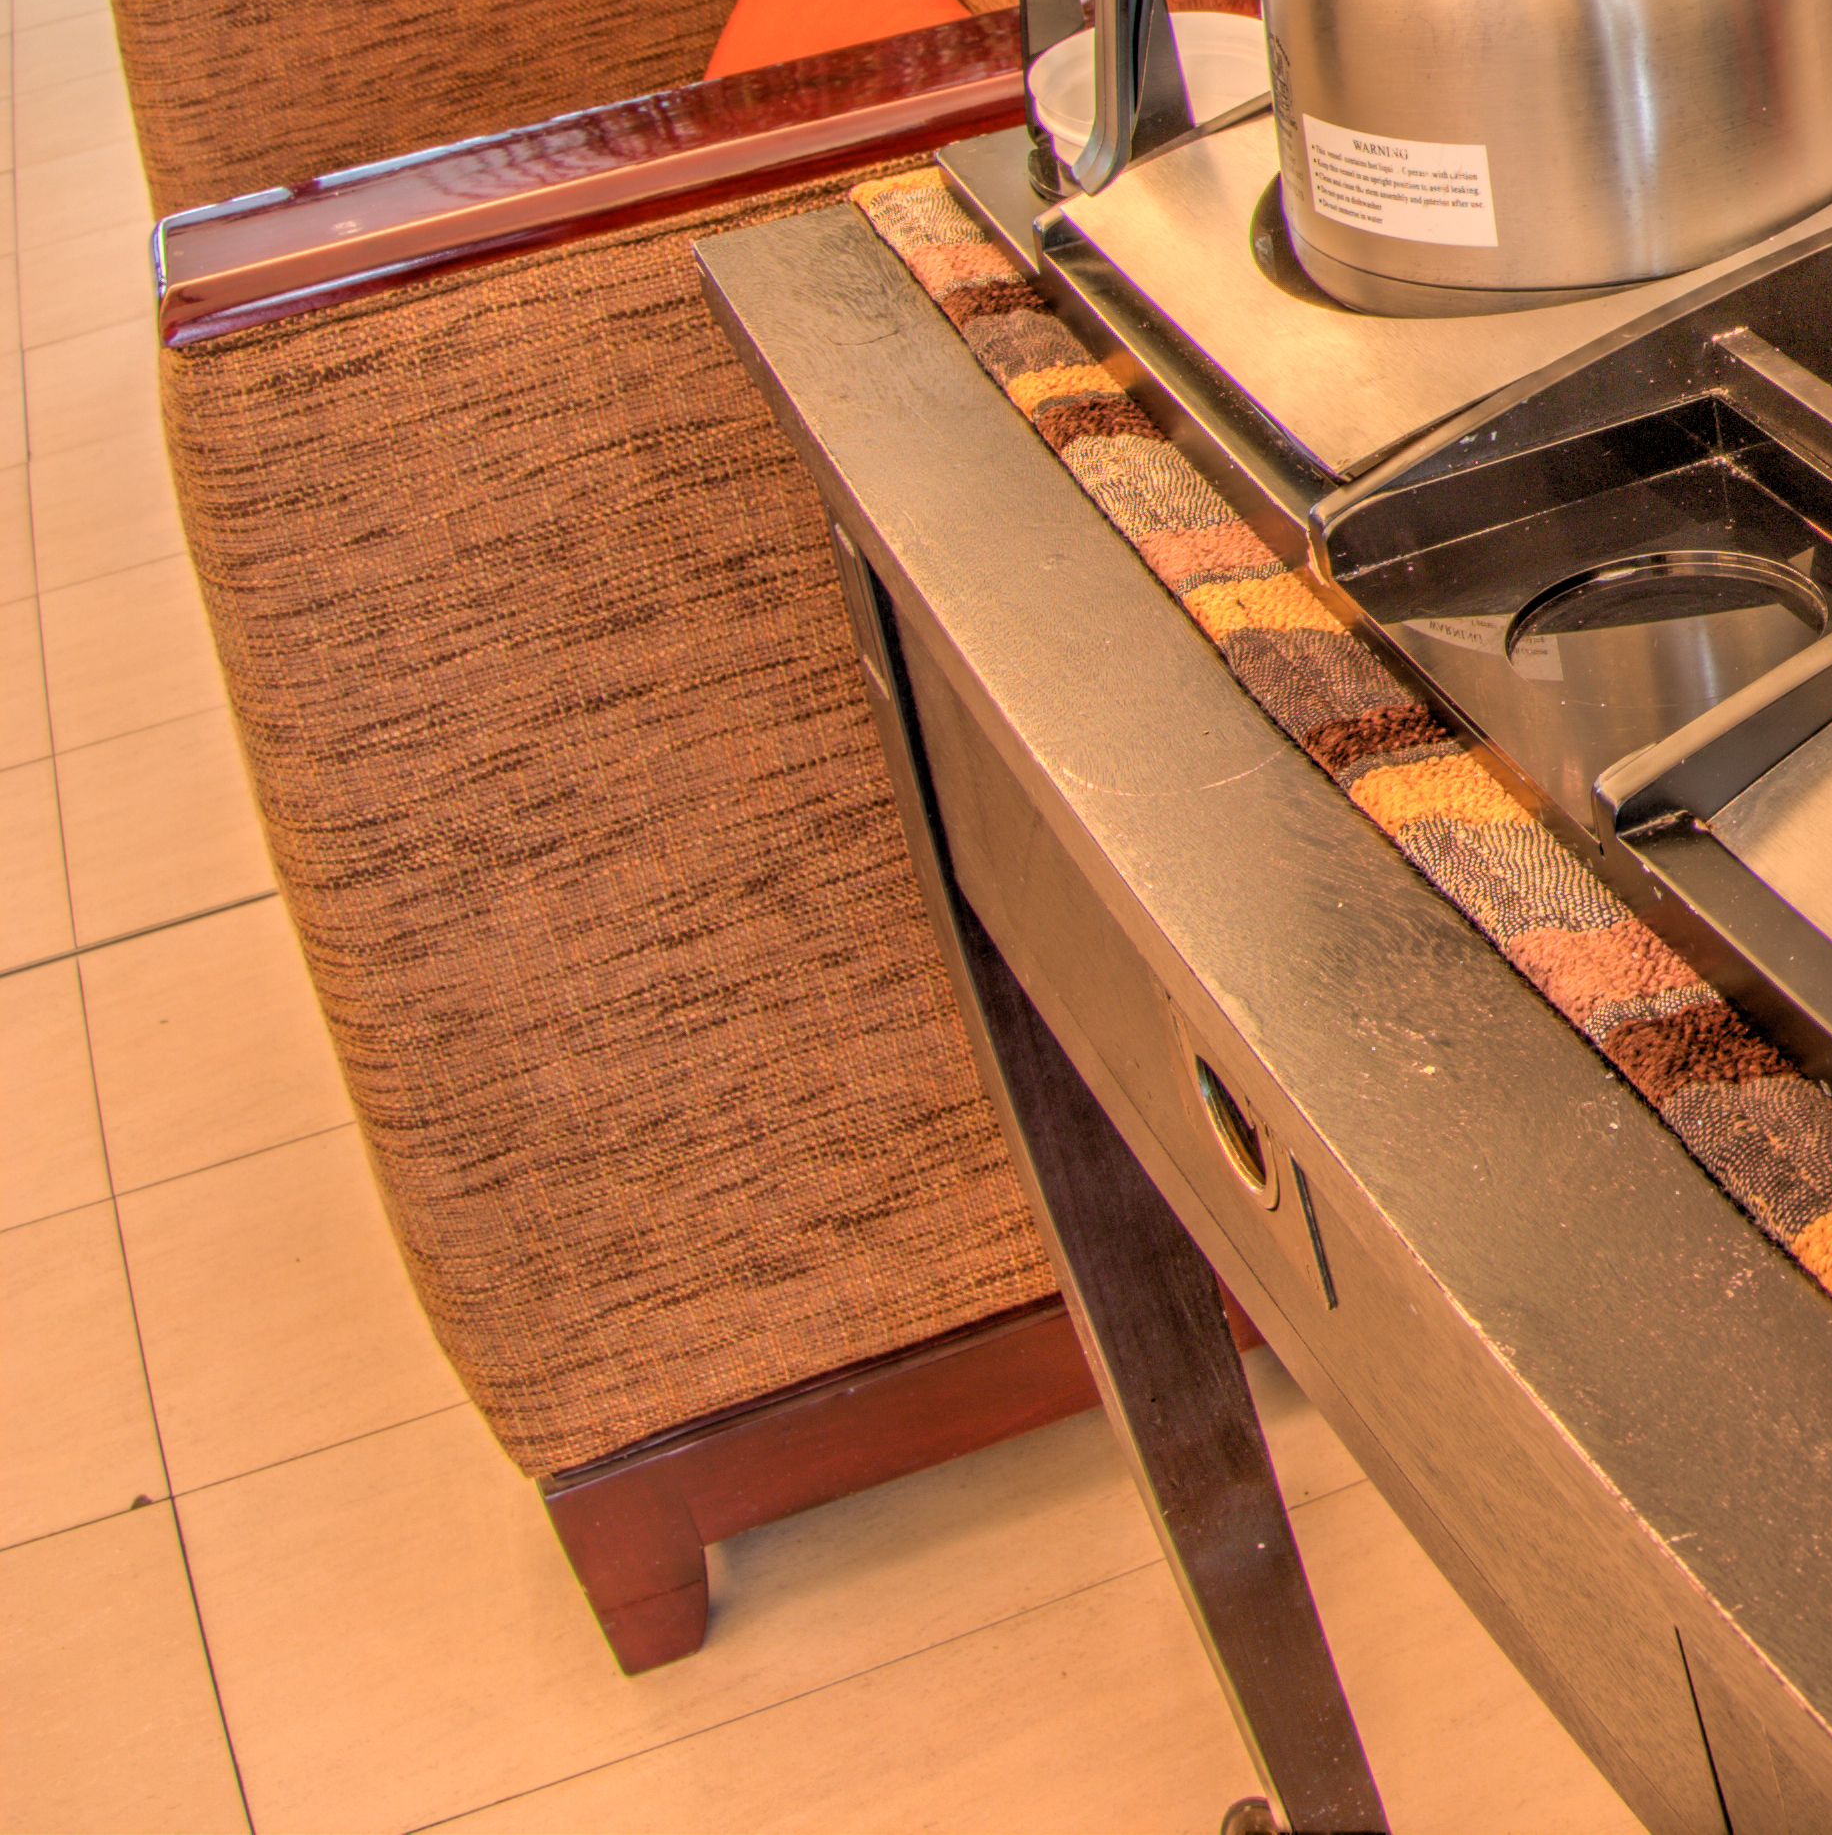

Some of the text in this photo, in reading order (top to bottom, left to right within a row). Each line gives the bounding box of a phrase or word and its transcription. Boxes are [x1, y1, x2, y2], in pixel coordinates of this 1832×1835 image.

[1353, 139, 1408, 159] WARNING
[1432, 171, 1448, 179] with
[1370, 176, 1392, 188] upright
[1393, 180, 1420, 189] position
[1351, 196, 1382, 210] dishwasher
[1380, 191, 1408, 203] assembly
[1410, 196, 1422, 204] and
